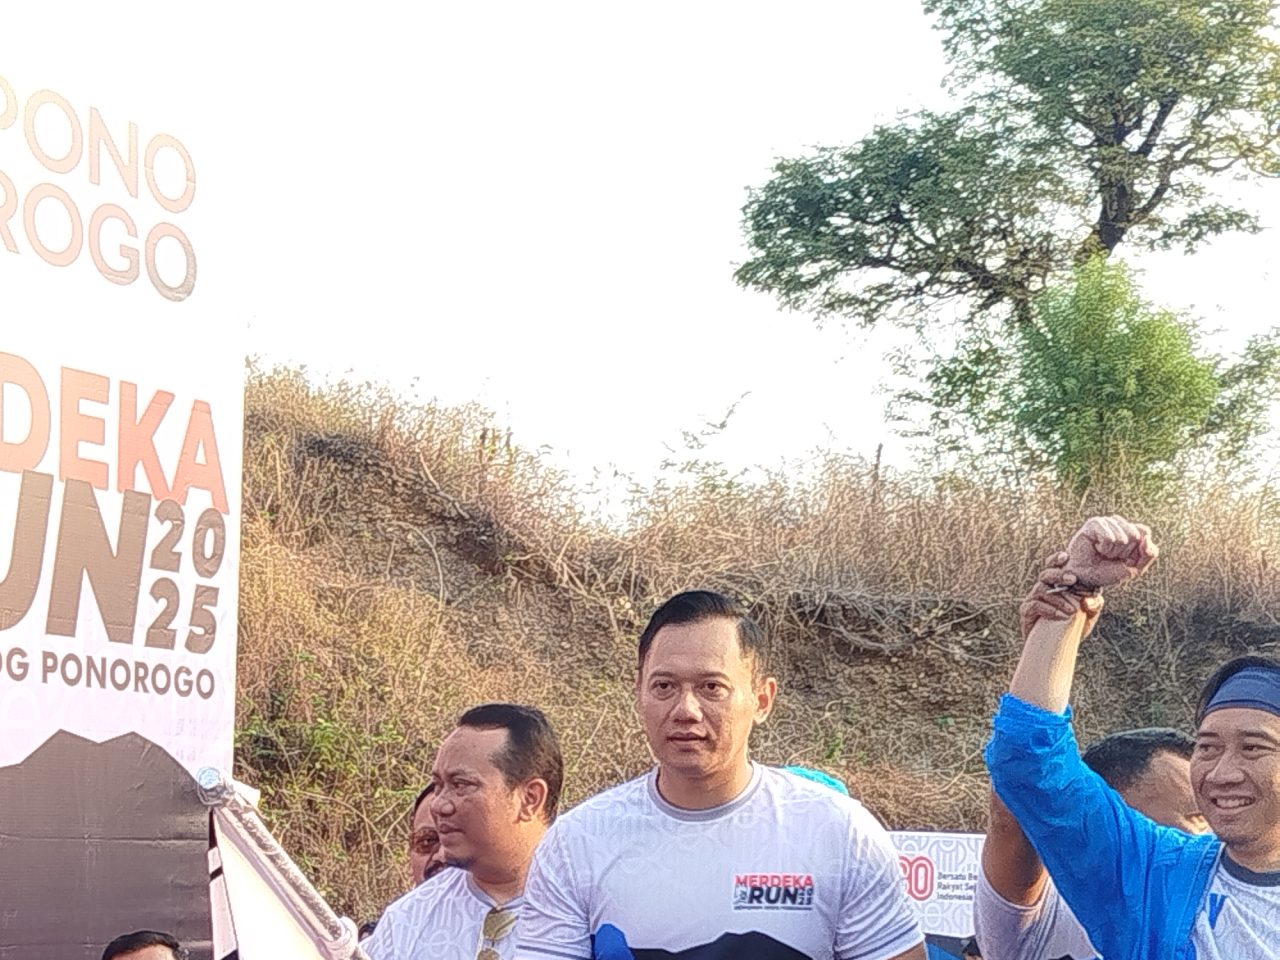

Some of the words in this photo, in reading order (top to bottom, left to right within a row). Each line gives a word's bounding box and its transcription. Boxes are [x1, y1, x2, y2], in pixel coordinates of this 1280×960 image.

[149, 500, 226, 579] 20
[144, 577, 221, 655] 25
[41, 650, 216, 700] PONOROGO
[735, 874, 813, 888] MERDEKA
[748, 886, 799, 905] RUN
